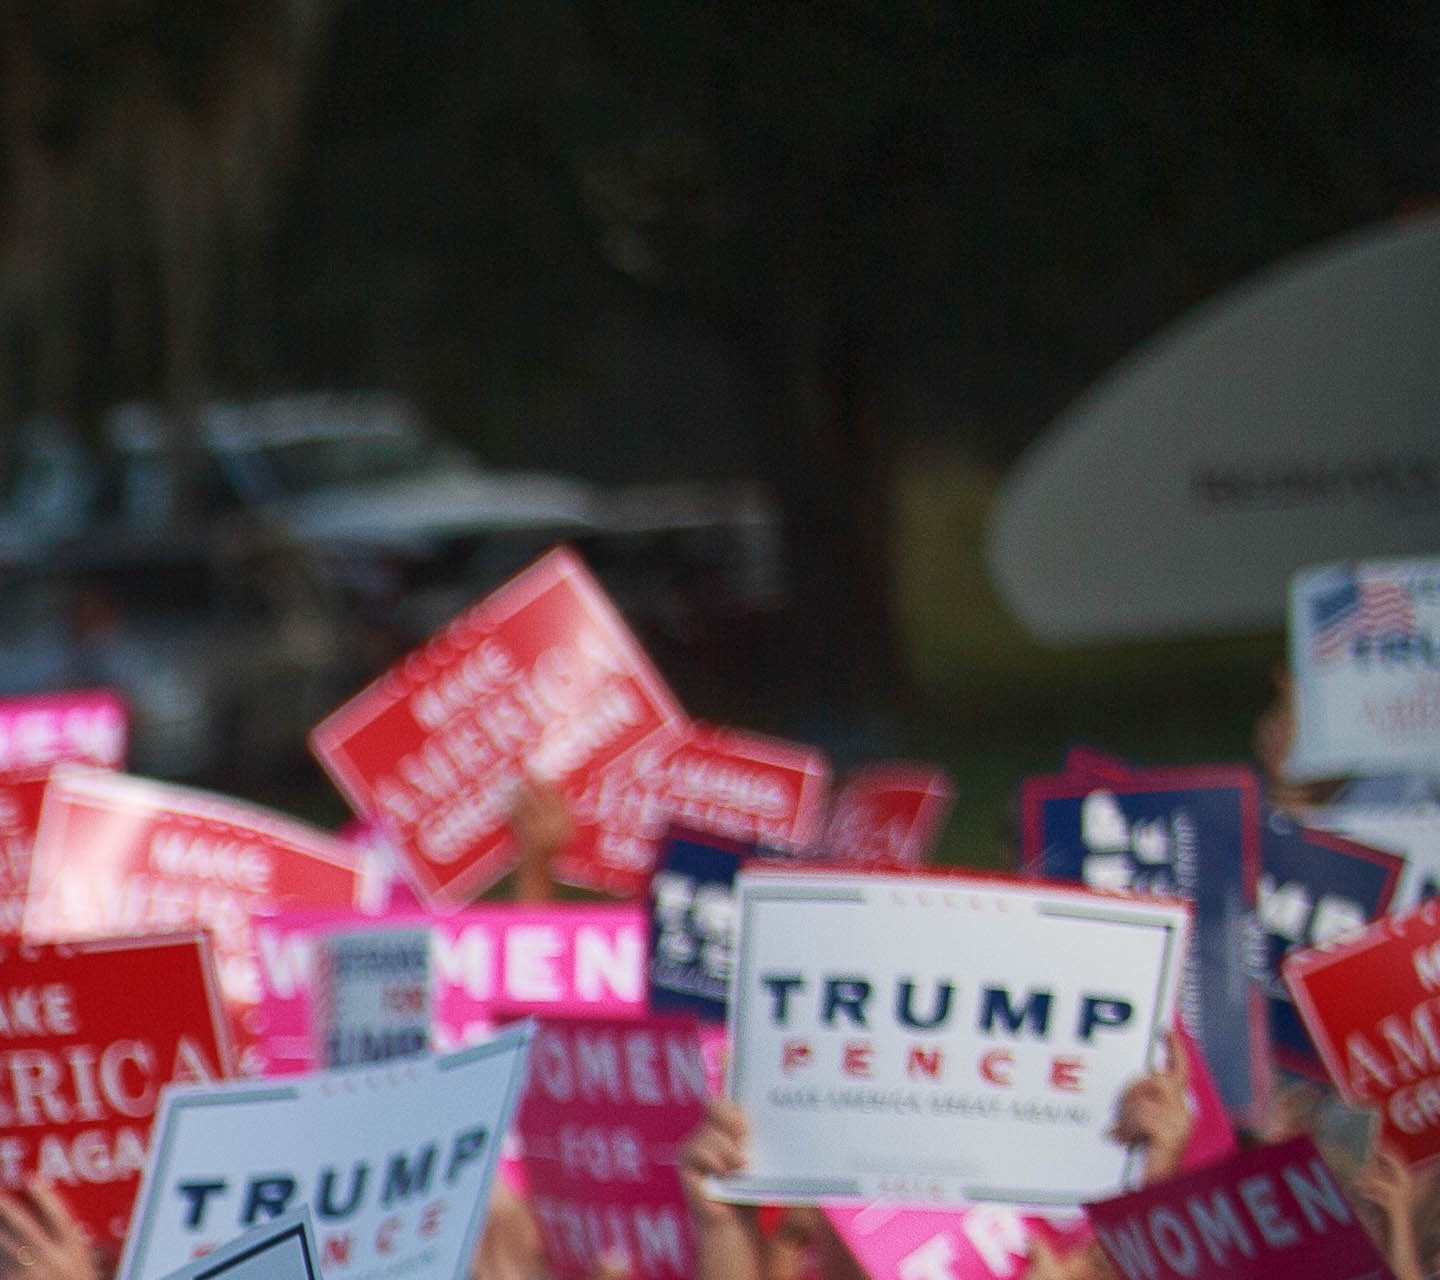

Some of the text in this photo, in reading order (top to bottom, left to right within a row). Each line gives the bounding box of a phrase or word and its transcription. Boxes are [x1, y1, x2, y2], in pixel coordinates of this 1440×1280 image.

[257, 921, 647, 1003] WMEN
[760, 970, 1136, 1045] TRUMP
[532, 1030, 708, 1105] OMEN
[781, 1039, 1086, 1094] PENCE
[177, 1122, 490, 1232] TRUMP
